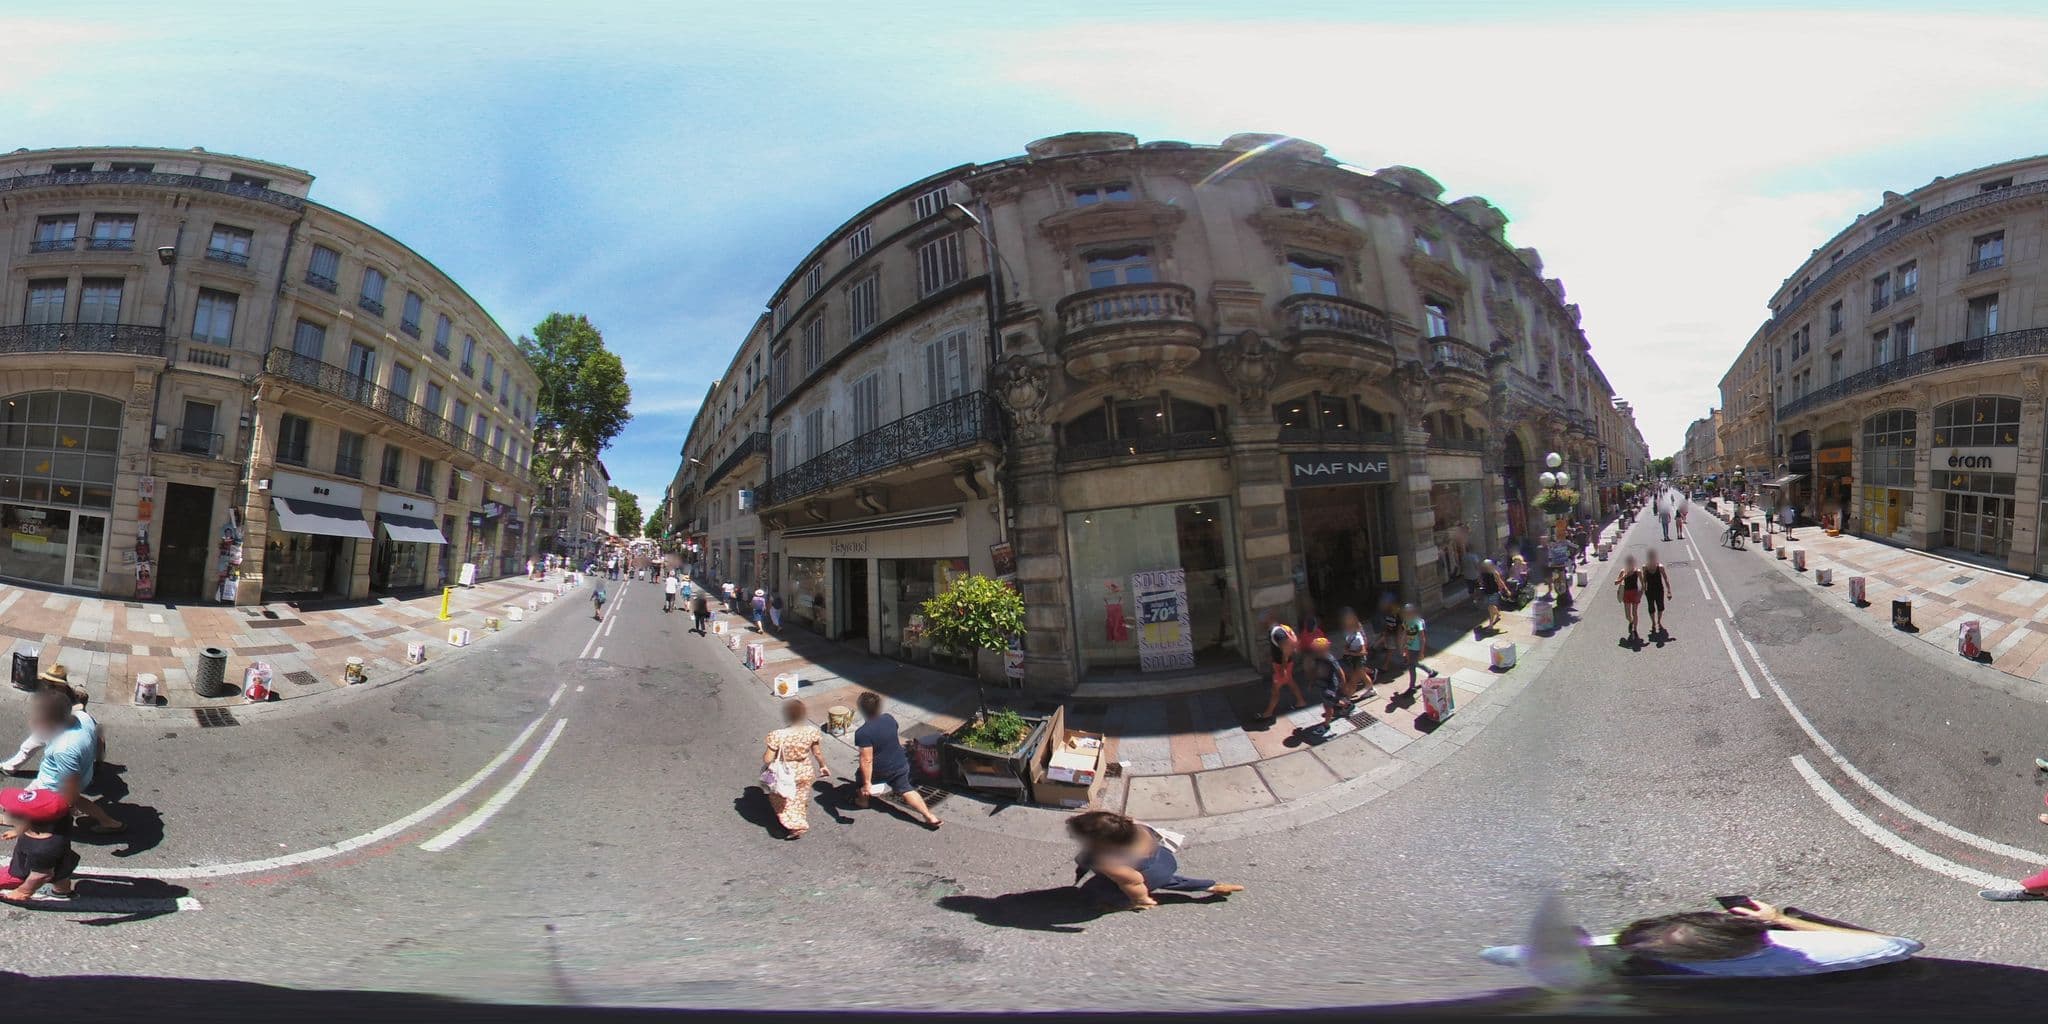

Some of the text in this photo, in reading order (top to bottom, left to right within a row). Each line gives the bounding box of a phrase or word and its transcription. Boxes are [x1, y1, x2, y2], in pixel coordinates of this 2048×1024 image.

[1947, 455, 1992, 468] eram
[1294, 462, 1388, 476] NAF NAF
[1144, 606, 1176, 622] -70%
